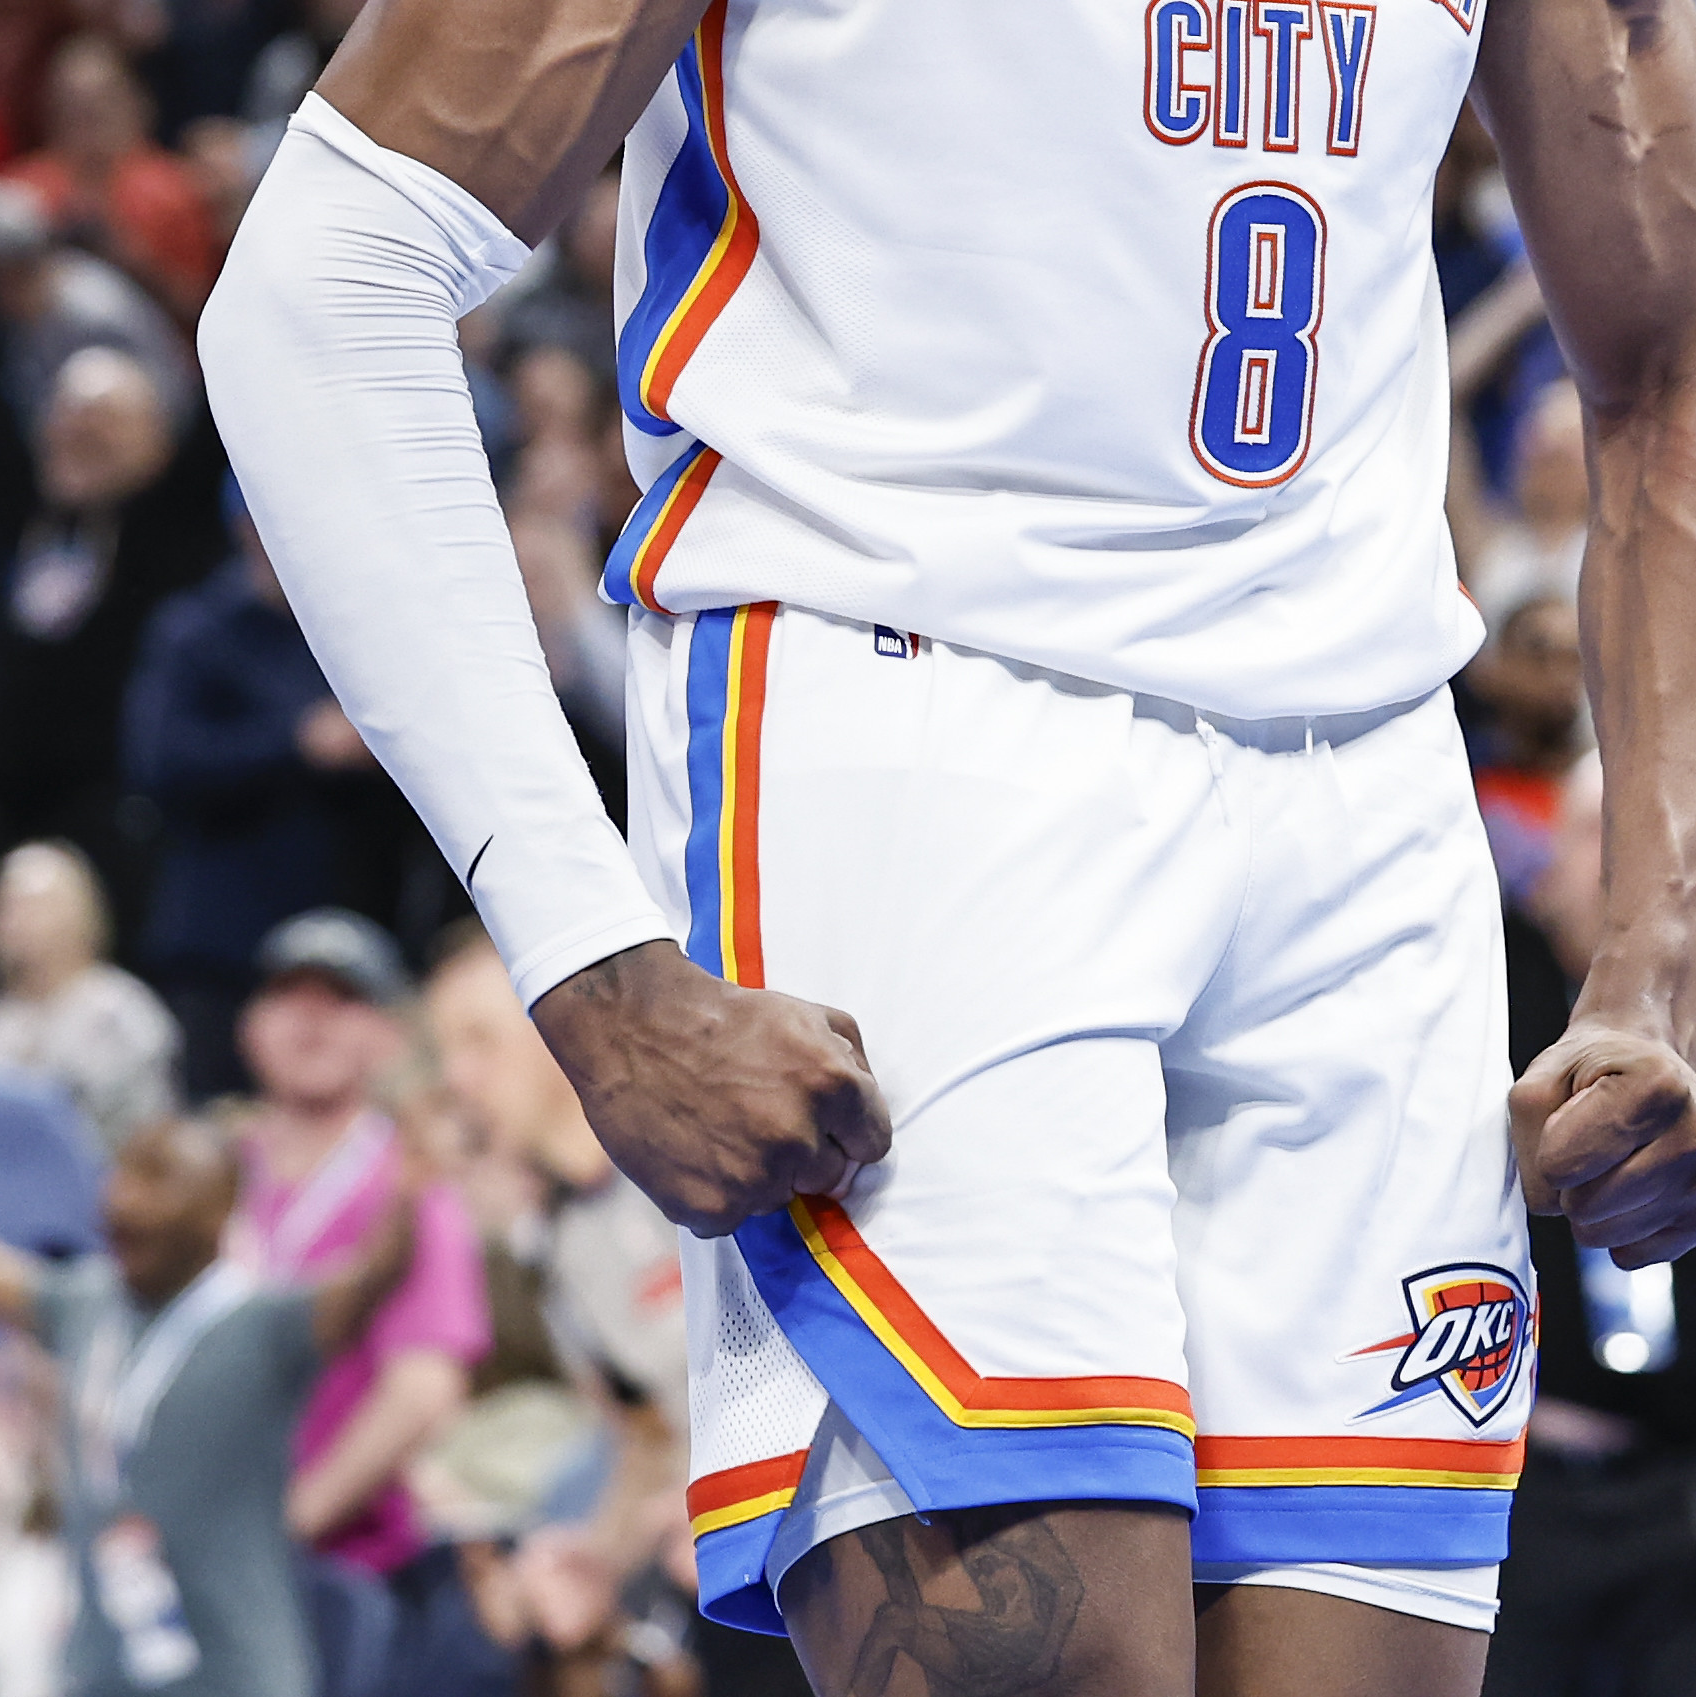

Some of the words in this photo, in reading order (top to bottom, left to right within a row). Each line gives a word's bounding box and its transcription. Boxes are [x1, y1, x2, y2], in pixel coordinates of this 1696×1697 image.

[1188, 180, 1327, 489] 8
[878, 635, 902, 654] NBA
[1396, 1300, 1515, 1385] OKC
